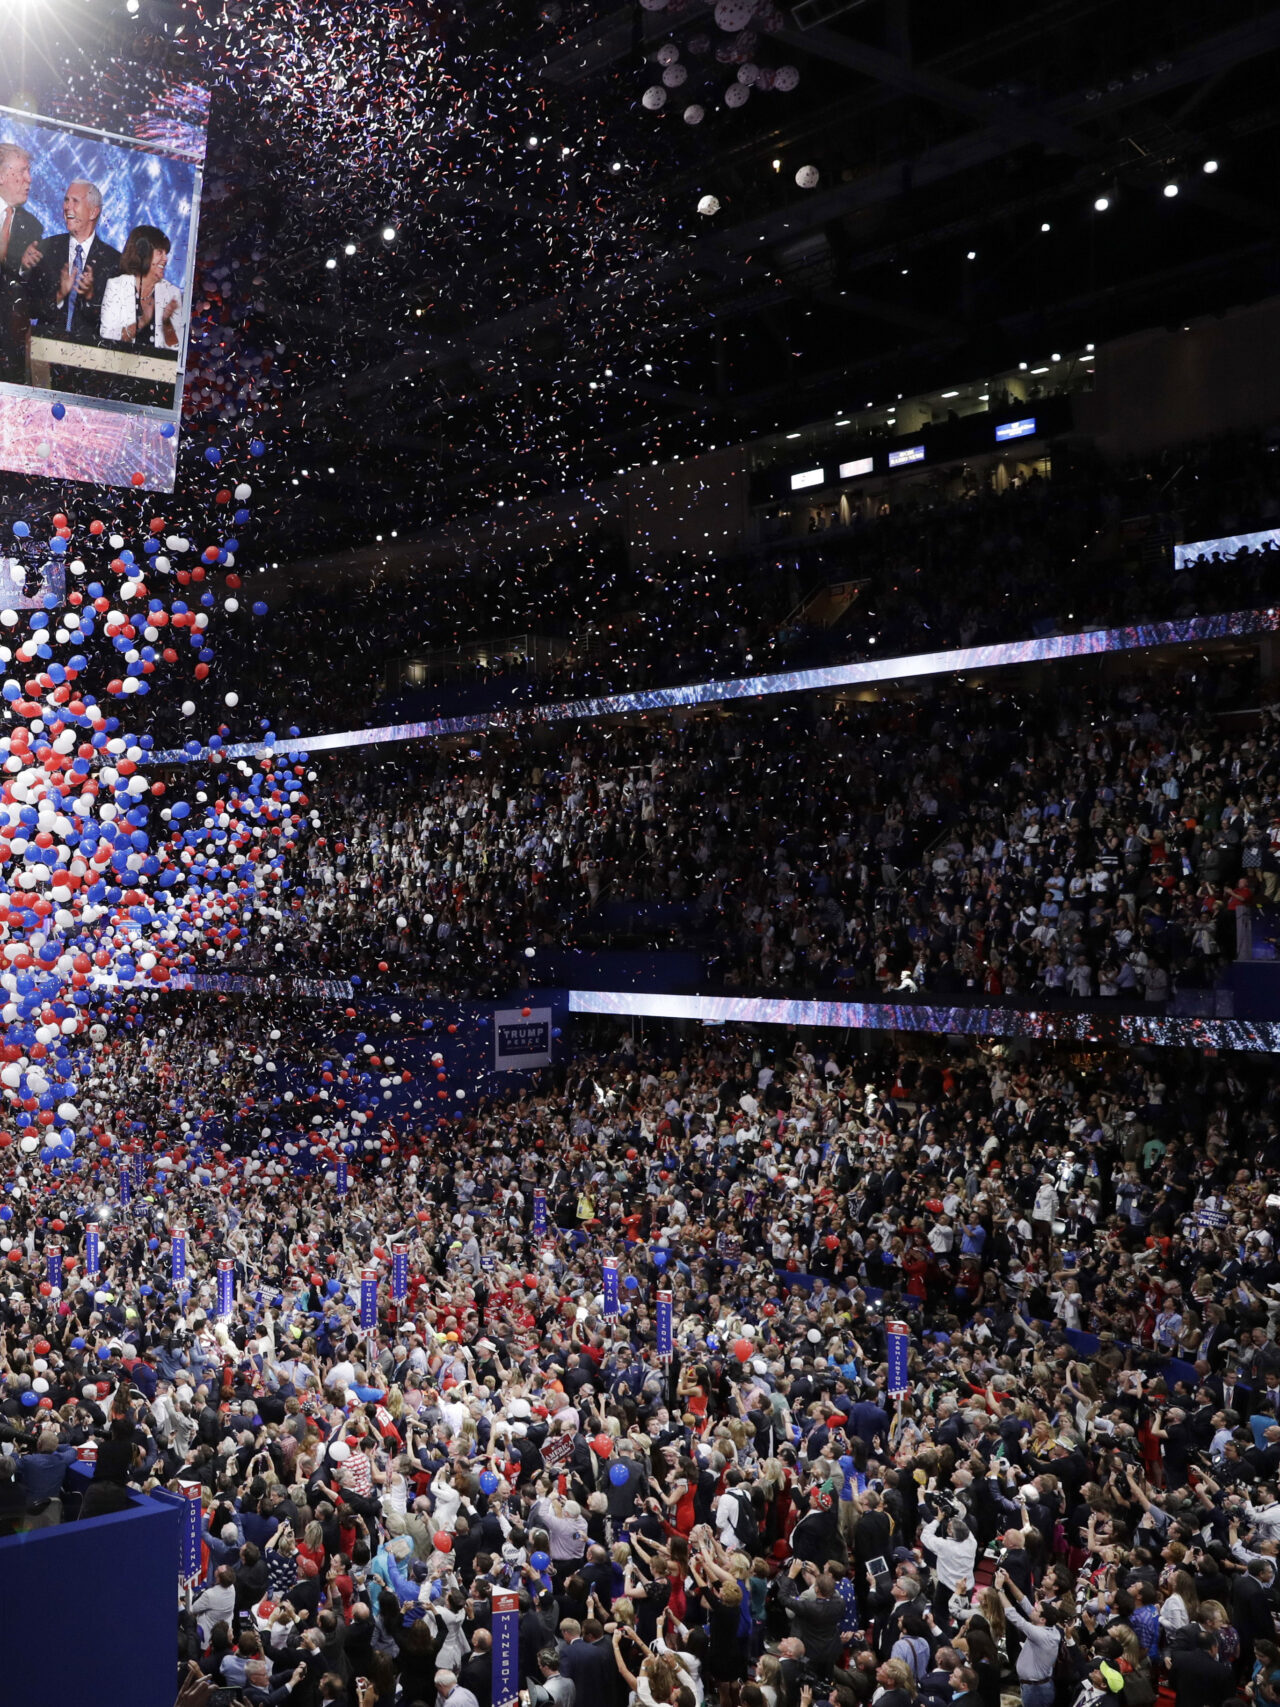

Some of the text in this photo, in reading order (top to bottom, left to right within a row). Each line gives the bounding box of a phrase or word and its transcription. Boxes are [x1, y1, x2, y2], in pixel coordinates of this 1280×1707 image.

[503, 1028, 544, 1039] TRUMP
[894, 1335, 902, 1387] WASHINGTON
[500, 1615, 511, 1694] MINNESOTA
